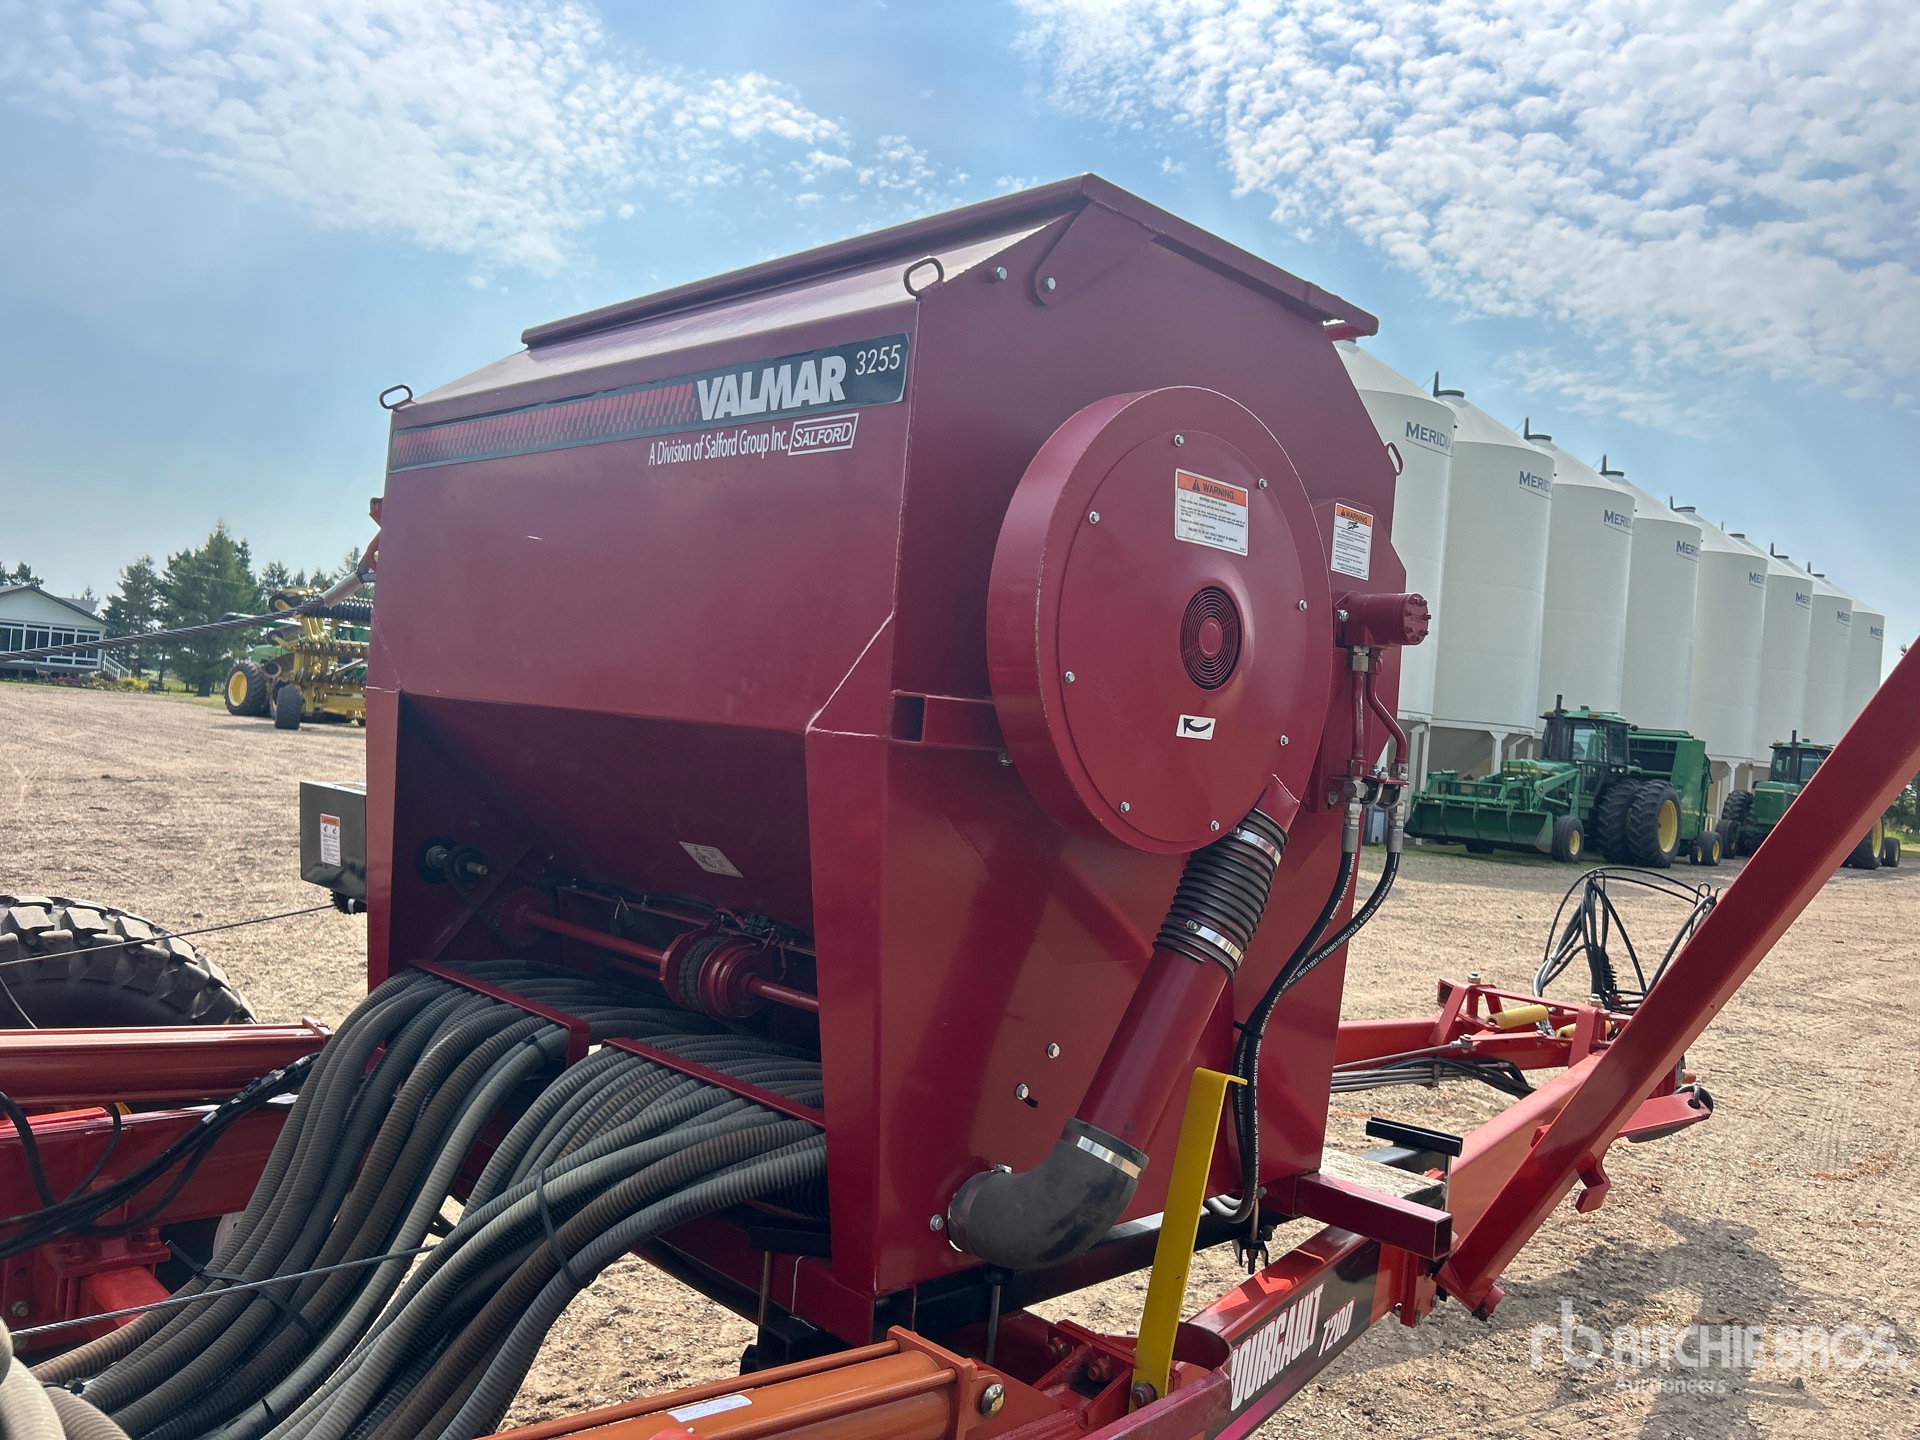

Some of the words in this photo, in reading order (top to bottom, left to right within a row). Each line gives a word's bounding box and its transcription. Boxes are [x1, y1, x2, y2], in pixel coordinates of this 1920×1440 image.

[697, 355, 847, 421] VALMAR
[855, 344, 902, 377] 3255
[648, 442, 656, 466] A
[657, 440, 692, 465] Division
[693, 434, 704, 461] of
[705, 429, 739, 460] Salford
[739, 429, 770, 460] Group
[771, 426, 789, 452] Inc.
[793, 421, 853, 448] SALFORD
[1202, 482, 1235, 501] WARNING
[1519, 470, 1553, 495] MERID
[1345, 511, 1368, 525] WARNING
[1317, 1297, 1356, 1358] 7200
